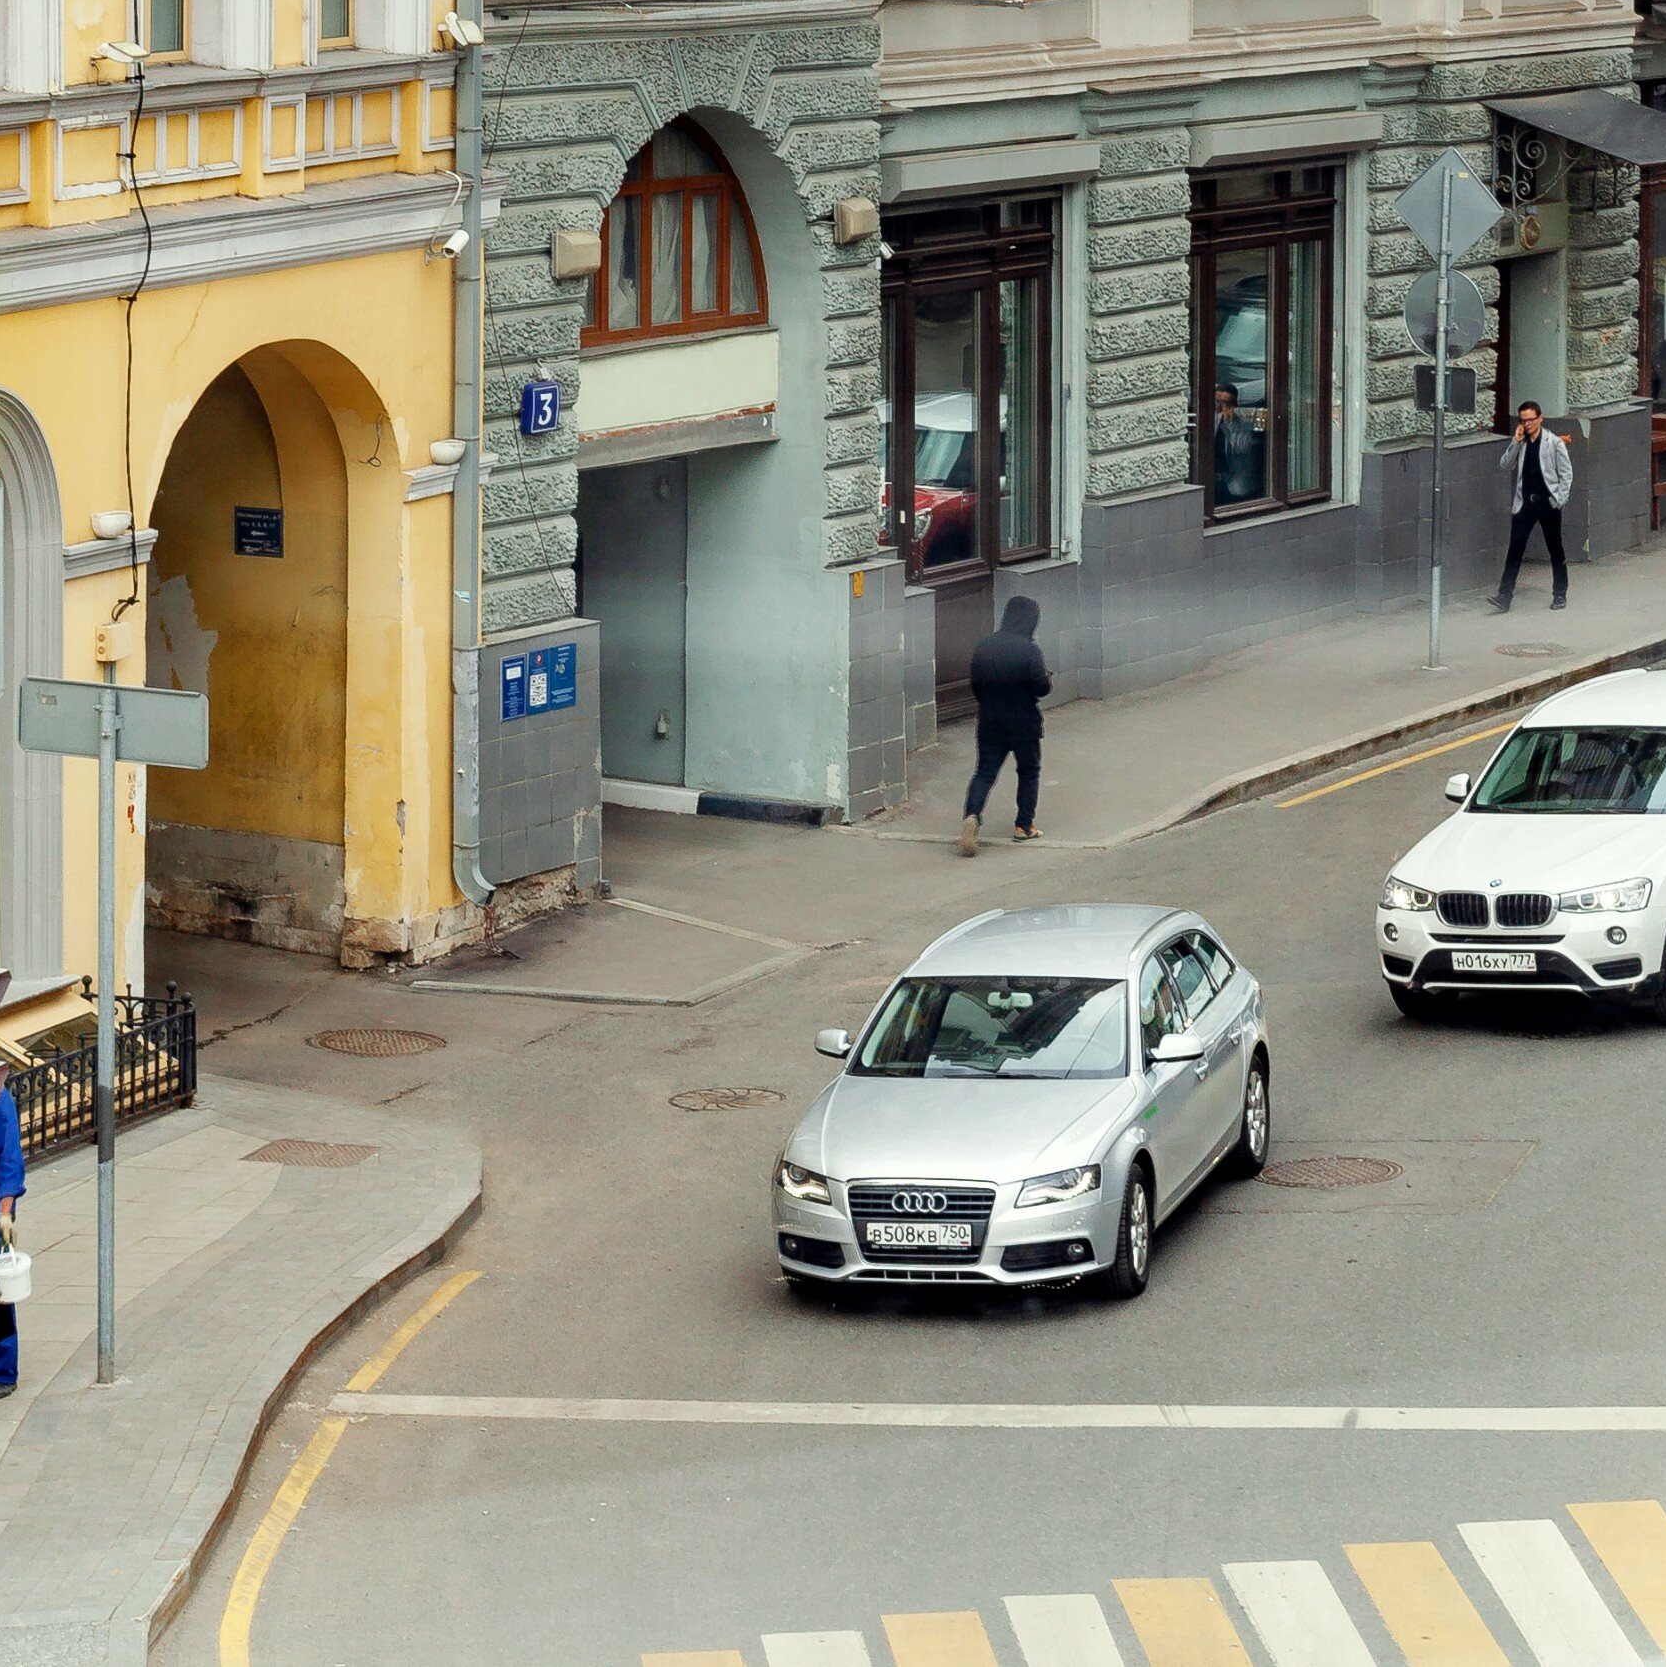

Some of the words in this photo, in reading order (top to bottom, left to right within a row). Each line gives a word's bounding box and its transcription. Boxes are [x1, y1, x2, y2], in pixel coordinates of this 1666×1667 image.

[538, 393, 552, 425] 3
[1456, 954, 1508, 969] Н016ХУ
[1510, 954, 1531, 965] 777
[873, 1226, 937, 1243] В508КВ
[941, 1226, 966, 1239] 750
